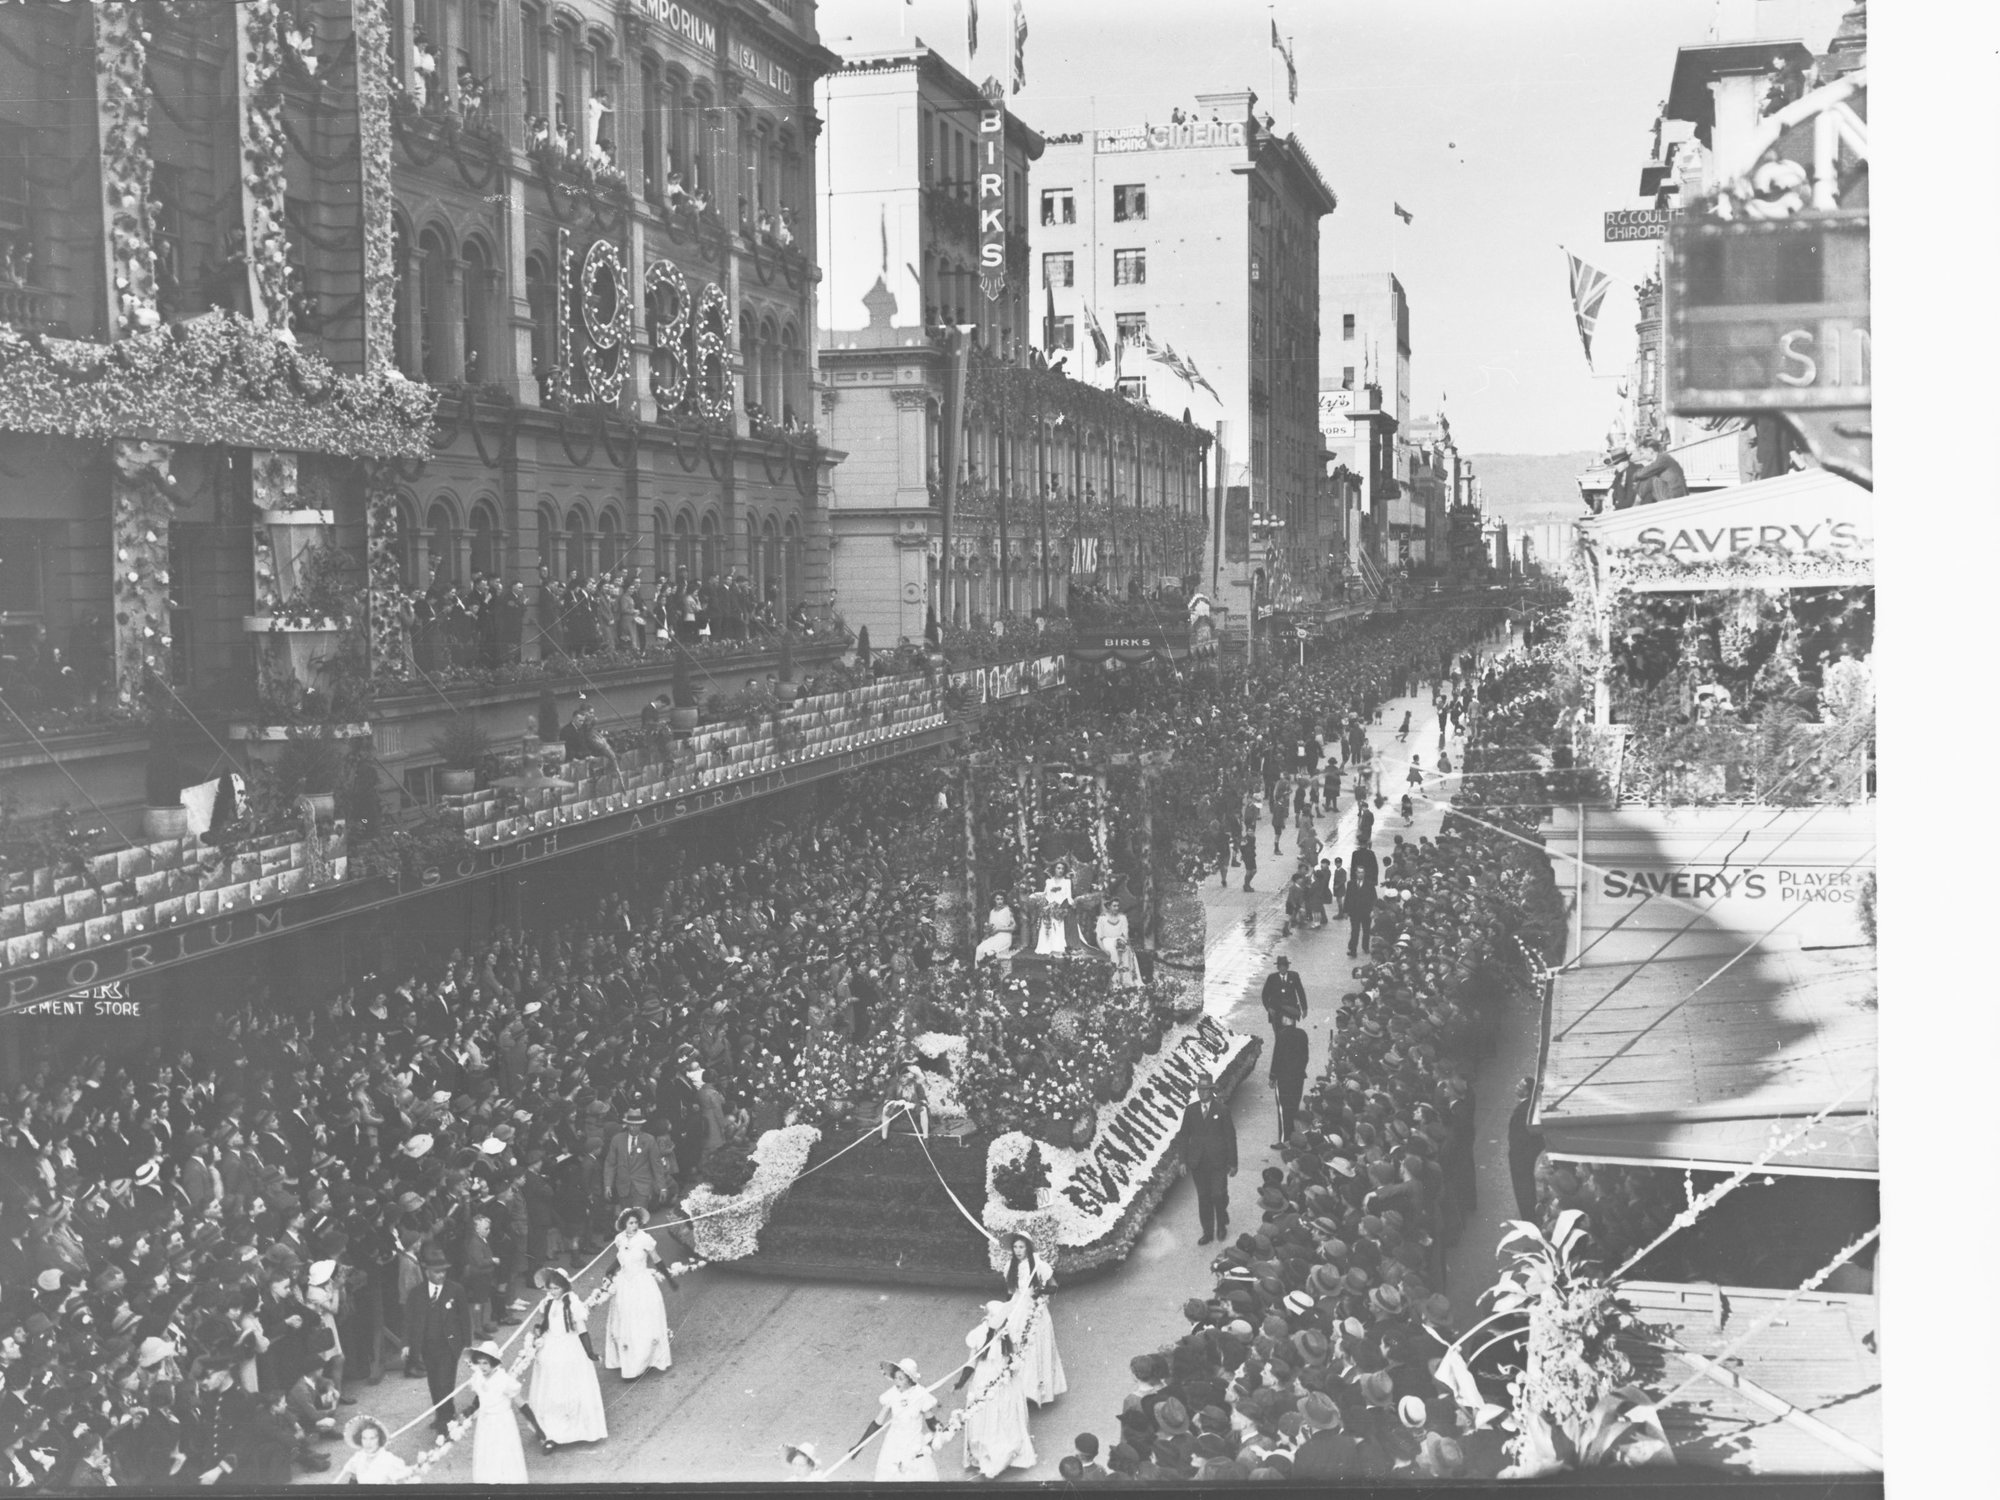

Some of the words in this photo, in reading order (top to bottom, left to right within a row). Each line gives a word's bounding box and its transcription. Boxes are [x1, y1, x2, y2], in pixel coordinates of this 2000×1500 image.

[768, 61, 791, 95] LTD
[1150, 123, 1247, 148] CINEMA
[980, 109, 1004, 267] BIRKS
[1637, 518, 1858, 554] SAVERY'S
[1105, 638, 1151, 647] BIRKS
[421, 834, 559, 887] SOUTH
[630, 770, 788, 831] AUSTRALIA
[1603, 869, 1767, 900] SAVERY'S
[1779, 870, 1852, 887] PLAYER
[1782, 887, 1856, 903] PIANOS
[94, 1001, 141, 1016] STORE
